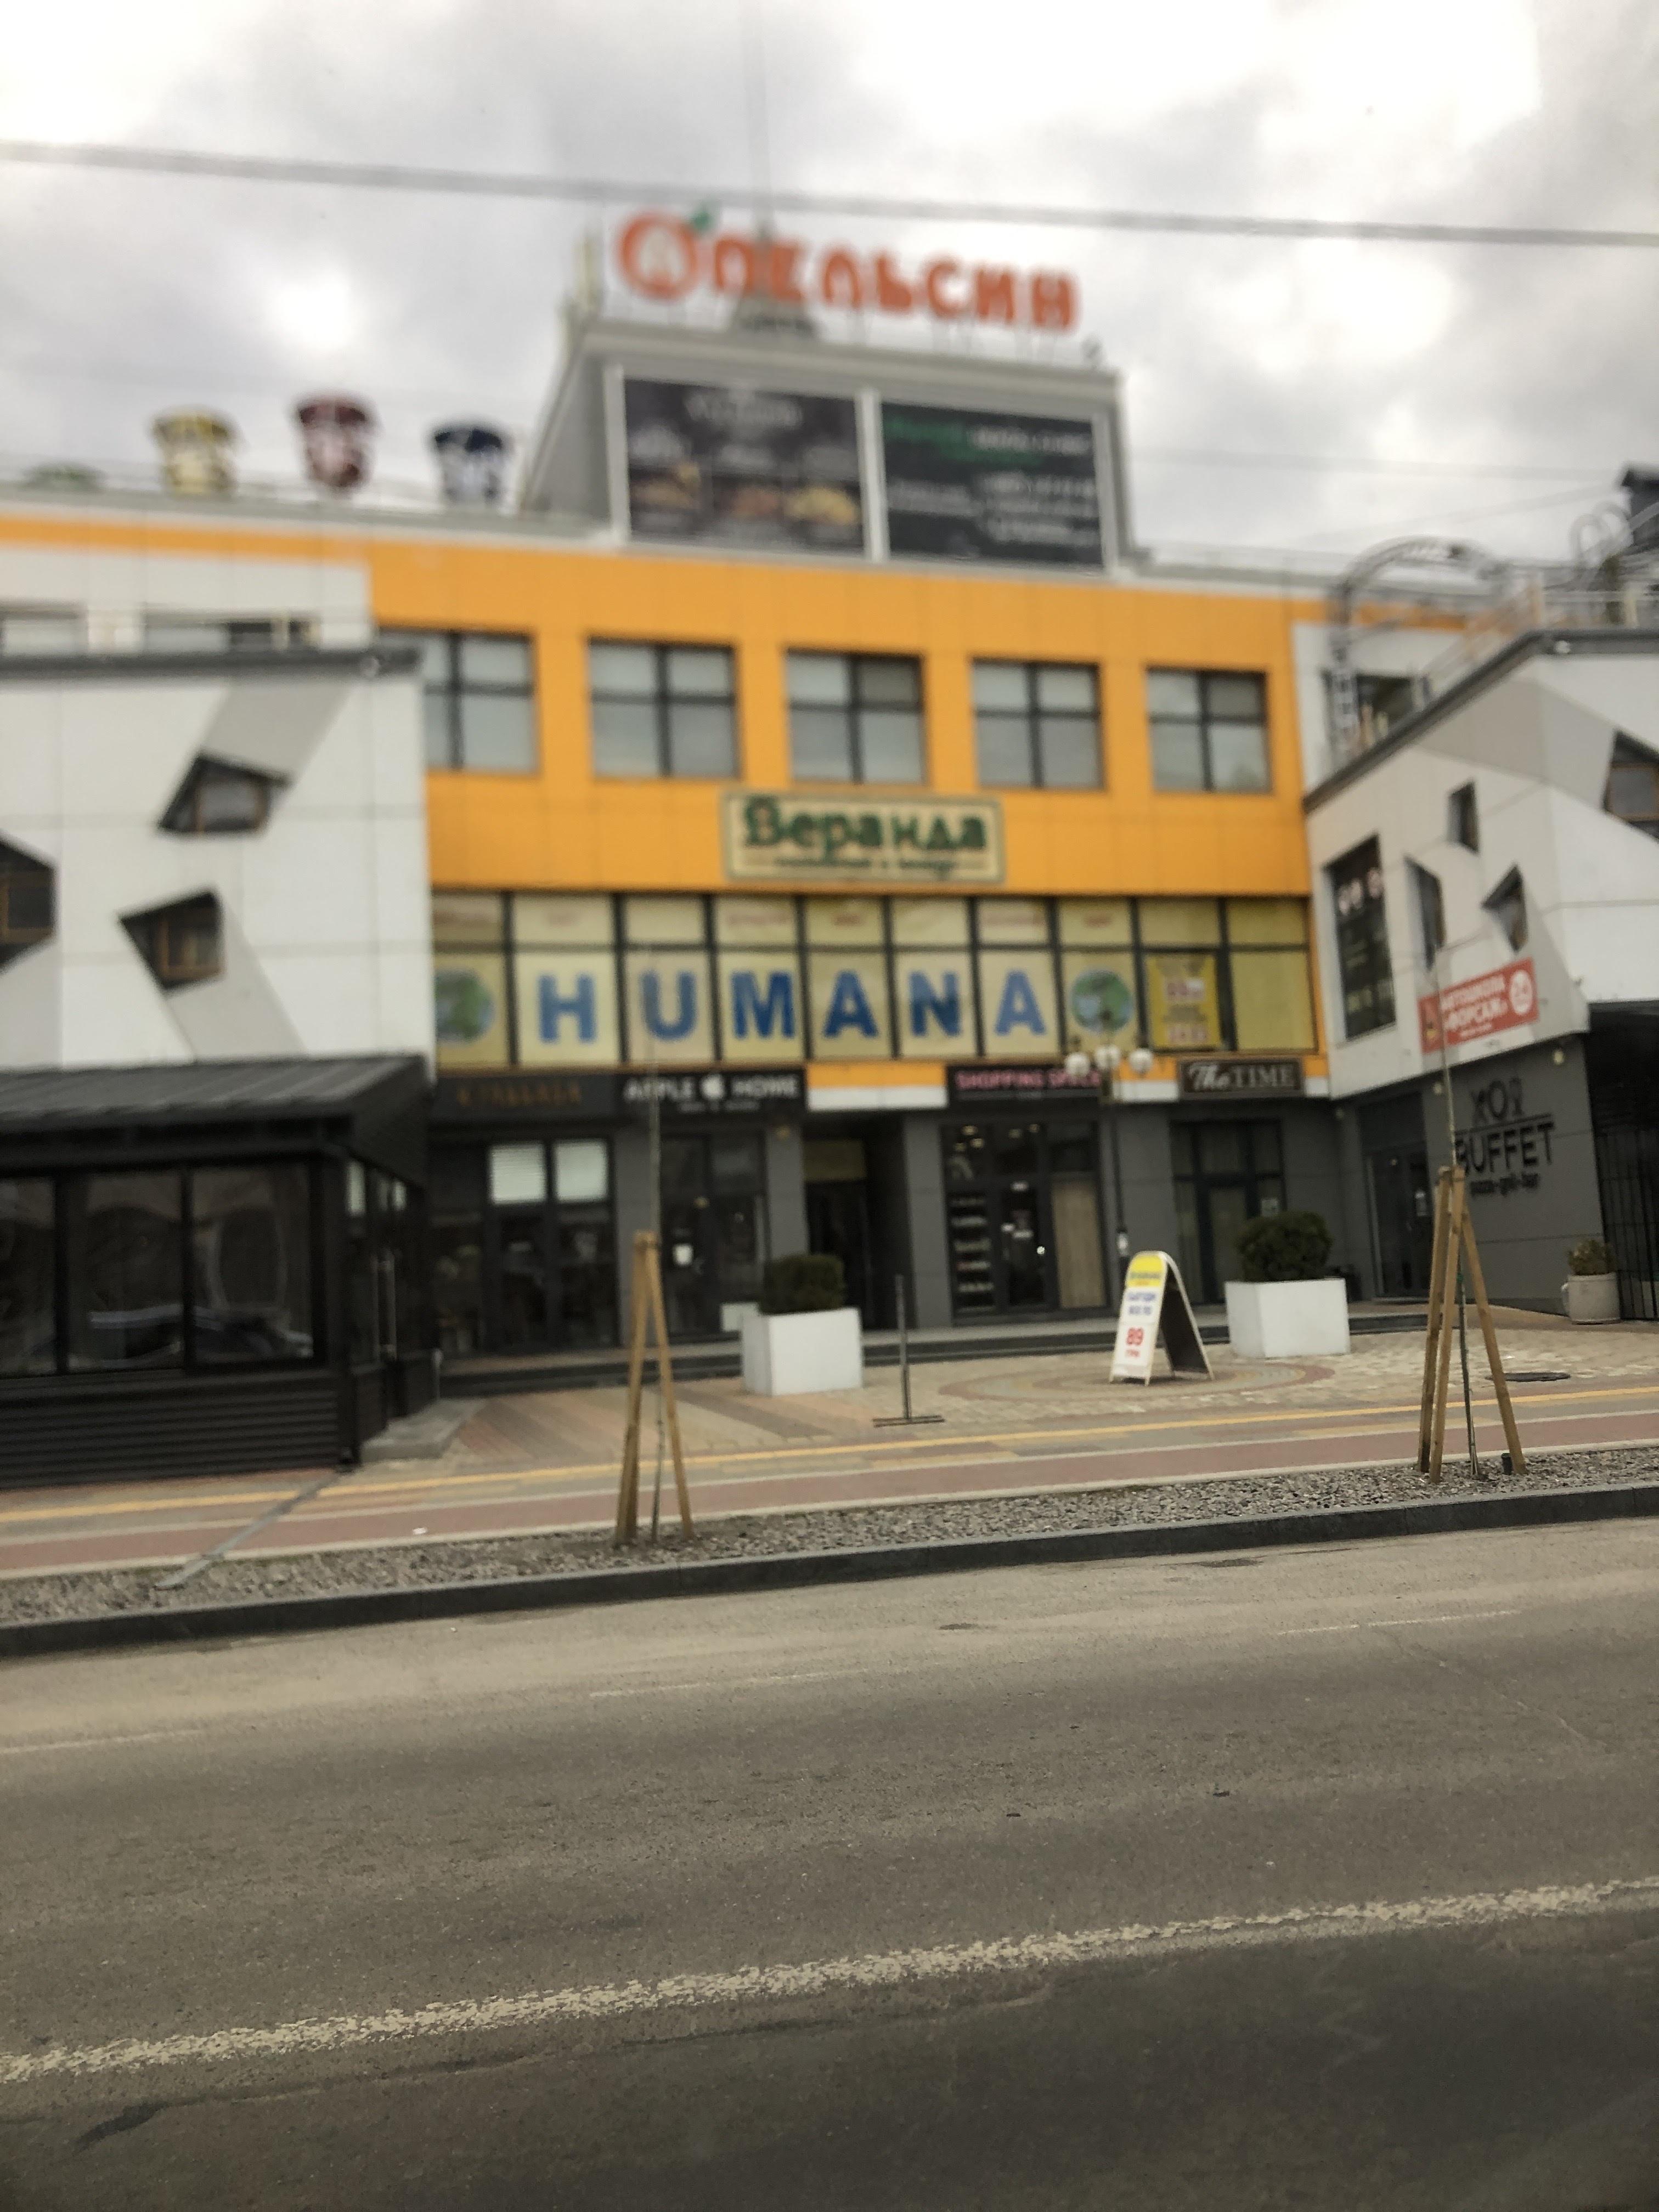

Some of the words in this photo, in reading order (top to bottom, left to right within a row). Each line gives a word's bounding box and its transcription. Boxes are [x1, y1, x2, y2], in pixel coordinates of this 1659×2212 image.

[538, 969, 1047, 1045] HUMANA
[623, 1075, 695, 1102] APPLE
[731, 1074, 799, 1099] HOME
[957, 1070, 1043, 1090] SHOPPING
[1232, 1064, 1294, 1088] TIME
[1455, 1122, 1555, 1177] BUFFET
